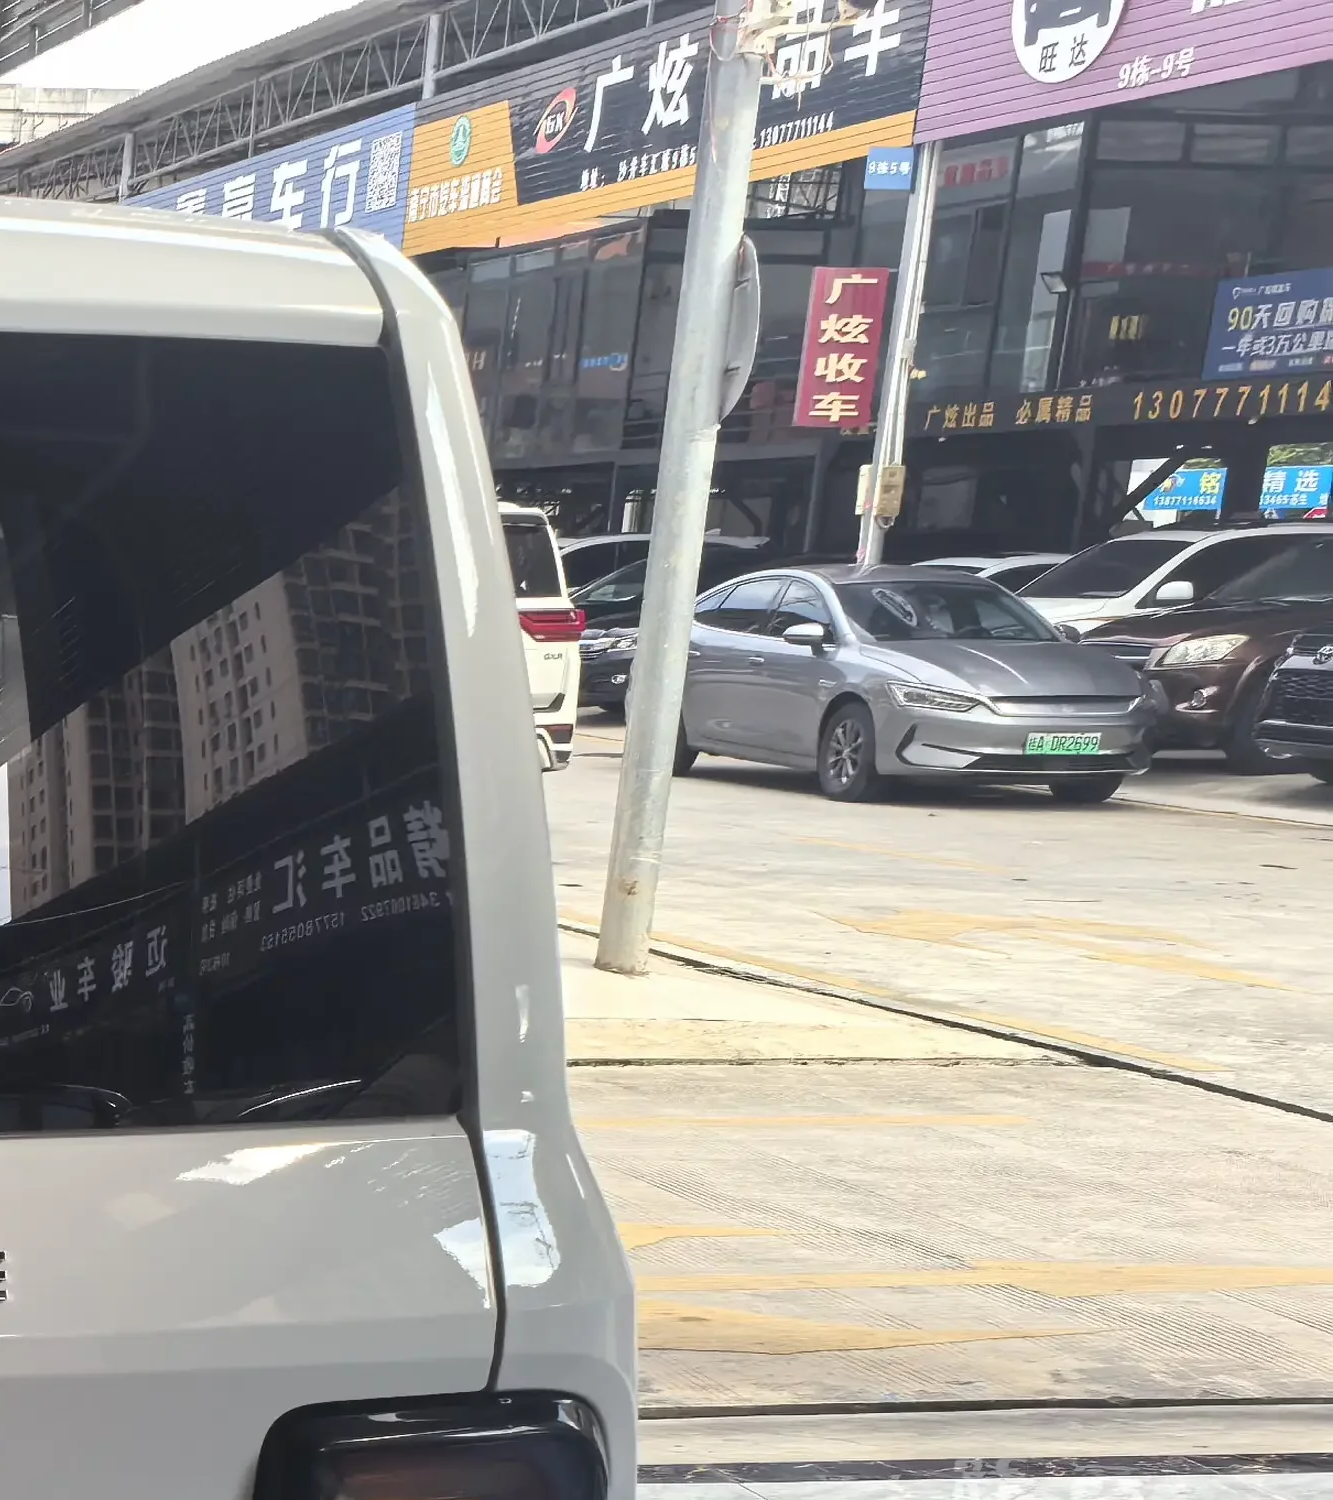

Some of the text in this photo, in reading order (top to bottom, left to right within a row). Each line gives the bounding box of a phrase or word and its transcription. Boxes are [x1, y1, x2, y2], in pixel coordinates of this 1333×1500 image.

[1039, 33, 1088, 73] 旺达
[1117, 47, 1195, 89] 9栋-9号
[808, 273, 879, 422] 广炫收车
[924, 394, 1093, 431] 广炫出品 必属精品
